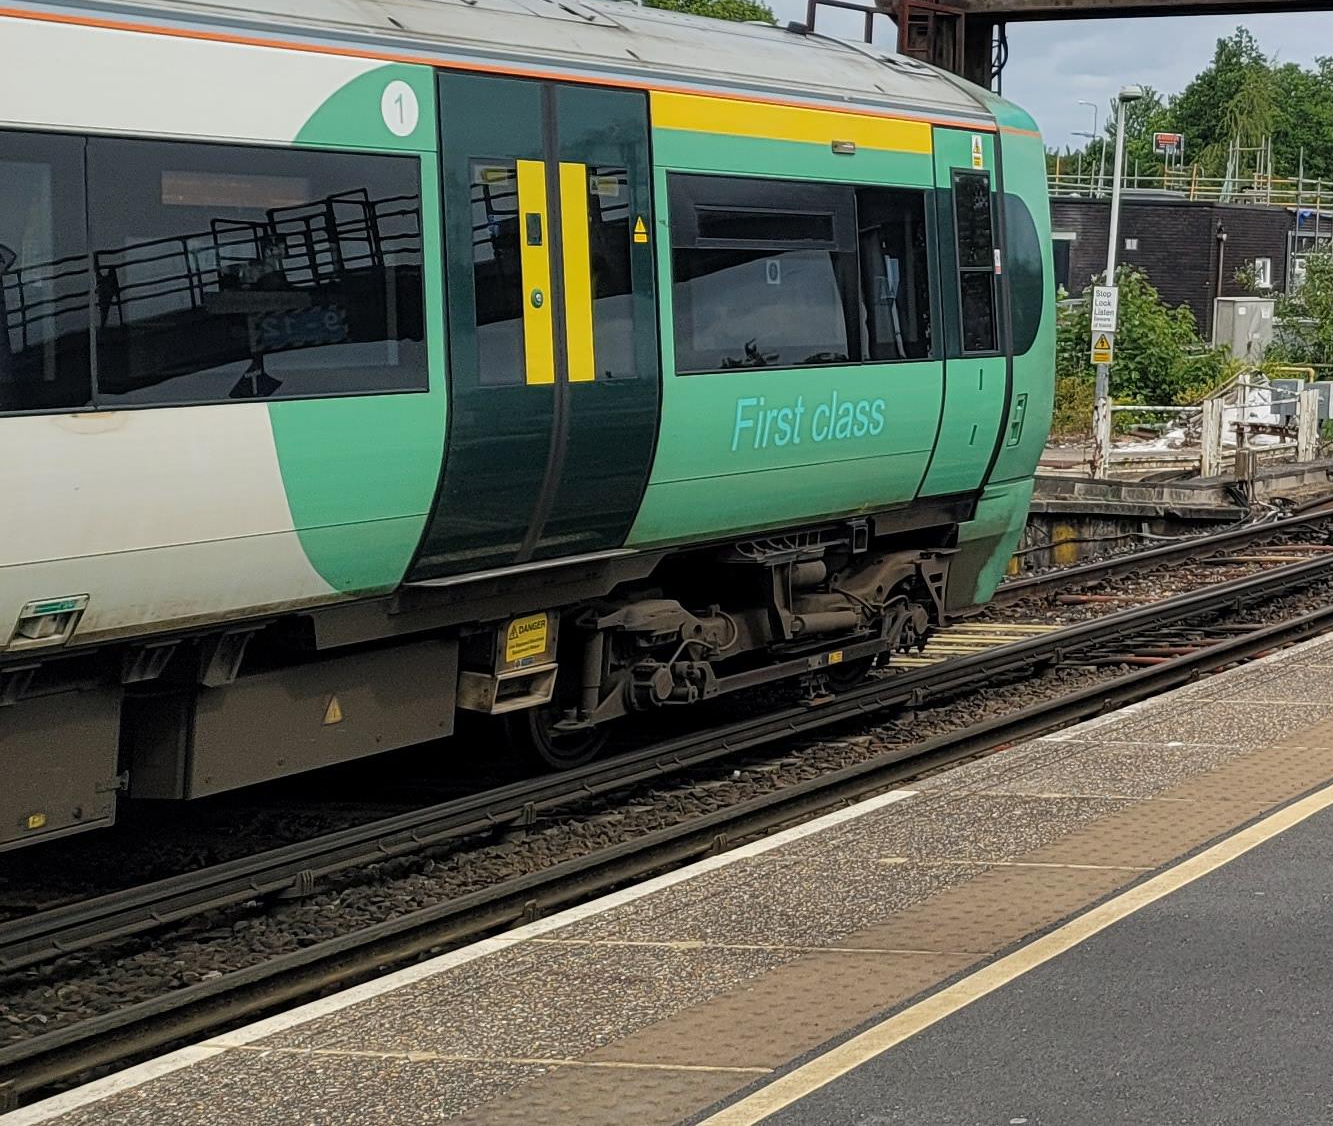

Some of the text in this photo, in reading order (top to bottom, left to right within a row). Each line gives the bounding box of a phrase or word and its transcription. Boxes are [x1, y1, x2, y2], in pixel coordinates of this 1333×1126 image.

[394, 93, 404, 124] 1
[731, 389, 886, 452] First class
[519, 619, 546, 635] DANGER
